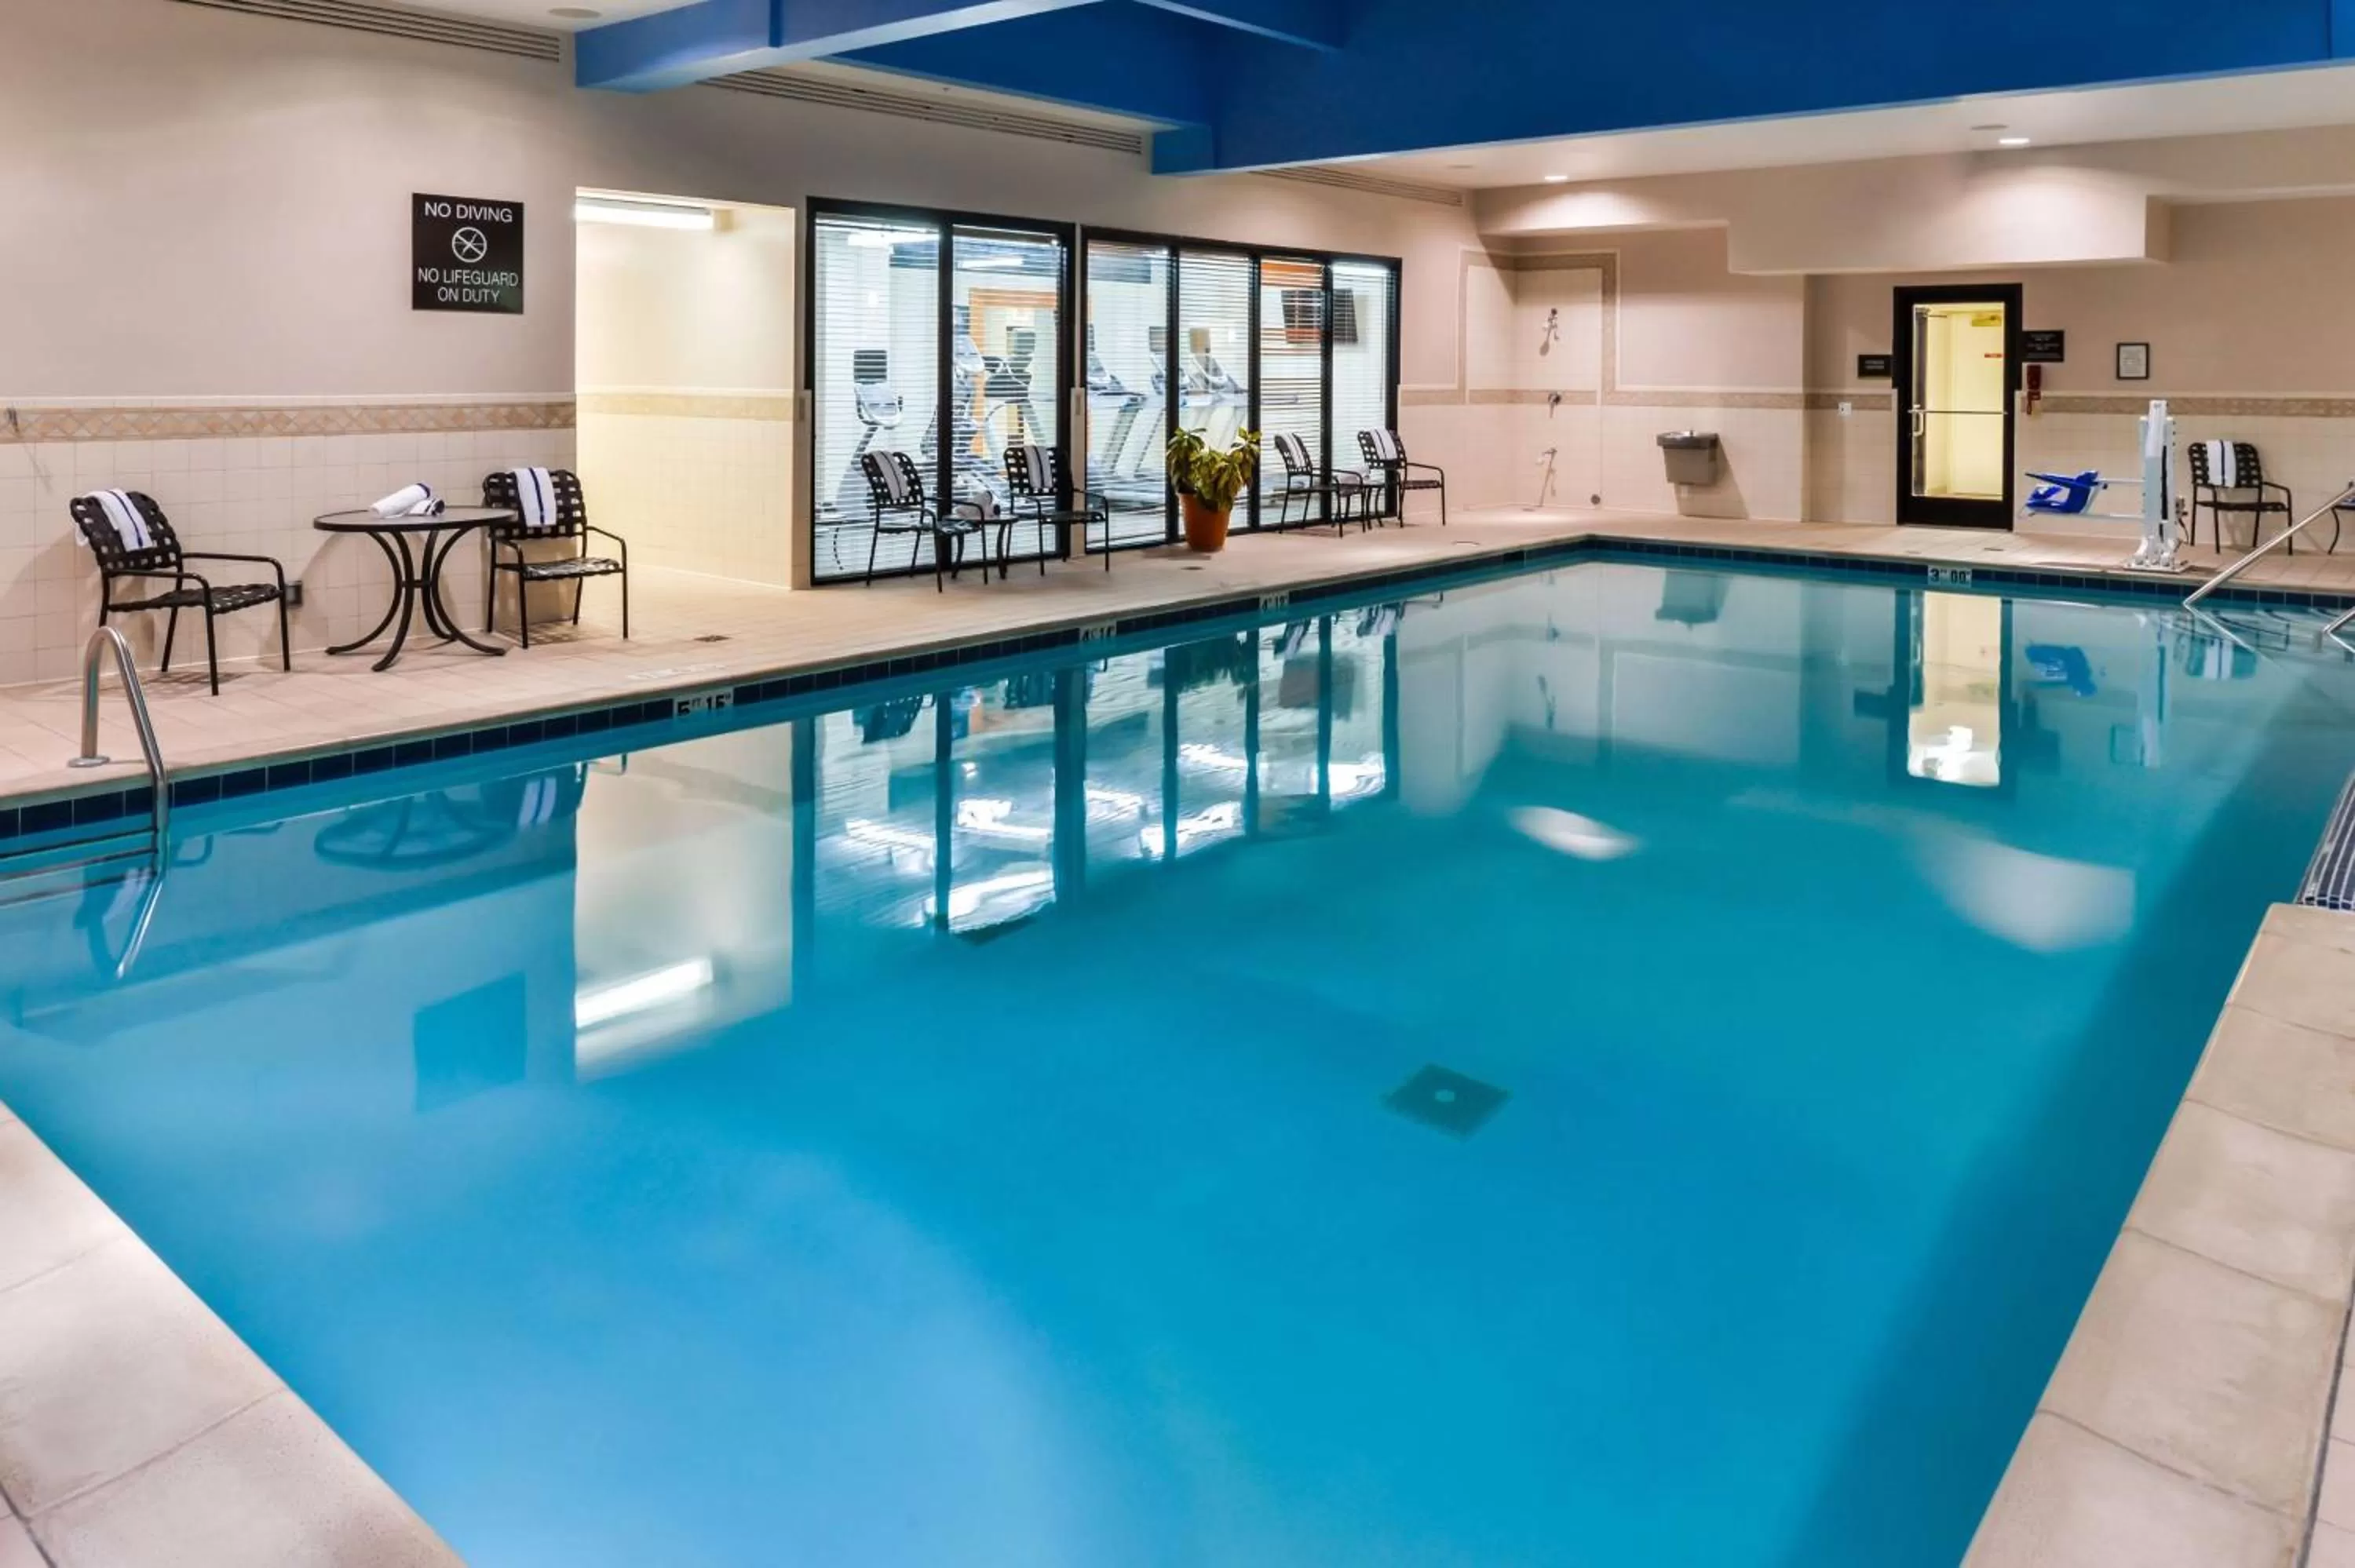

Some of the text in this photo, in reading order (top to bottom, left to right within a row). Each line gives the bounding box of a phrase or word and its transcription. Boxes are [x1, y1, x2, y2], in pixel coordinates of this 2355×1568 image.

[425, 201, 513, 223] NO DIVING
[418, 267, 519, 286] NO LIFEGUARD
[437, 286, 500, 304] ON DUTY
